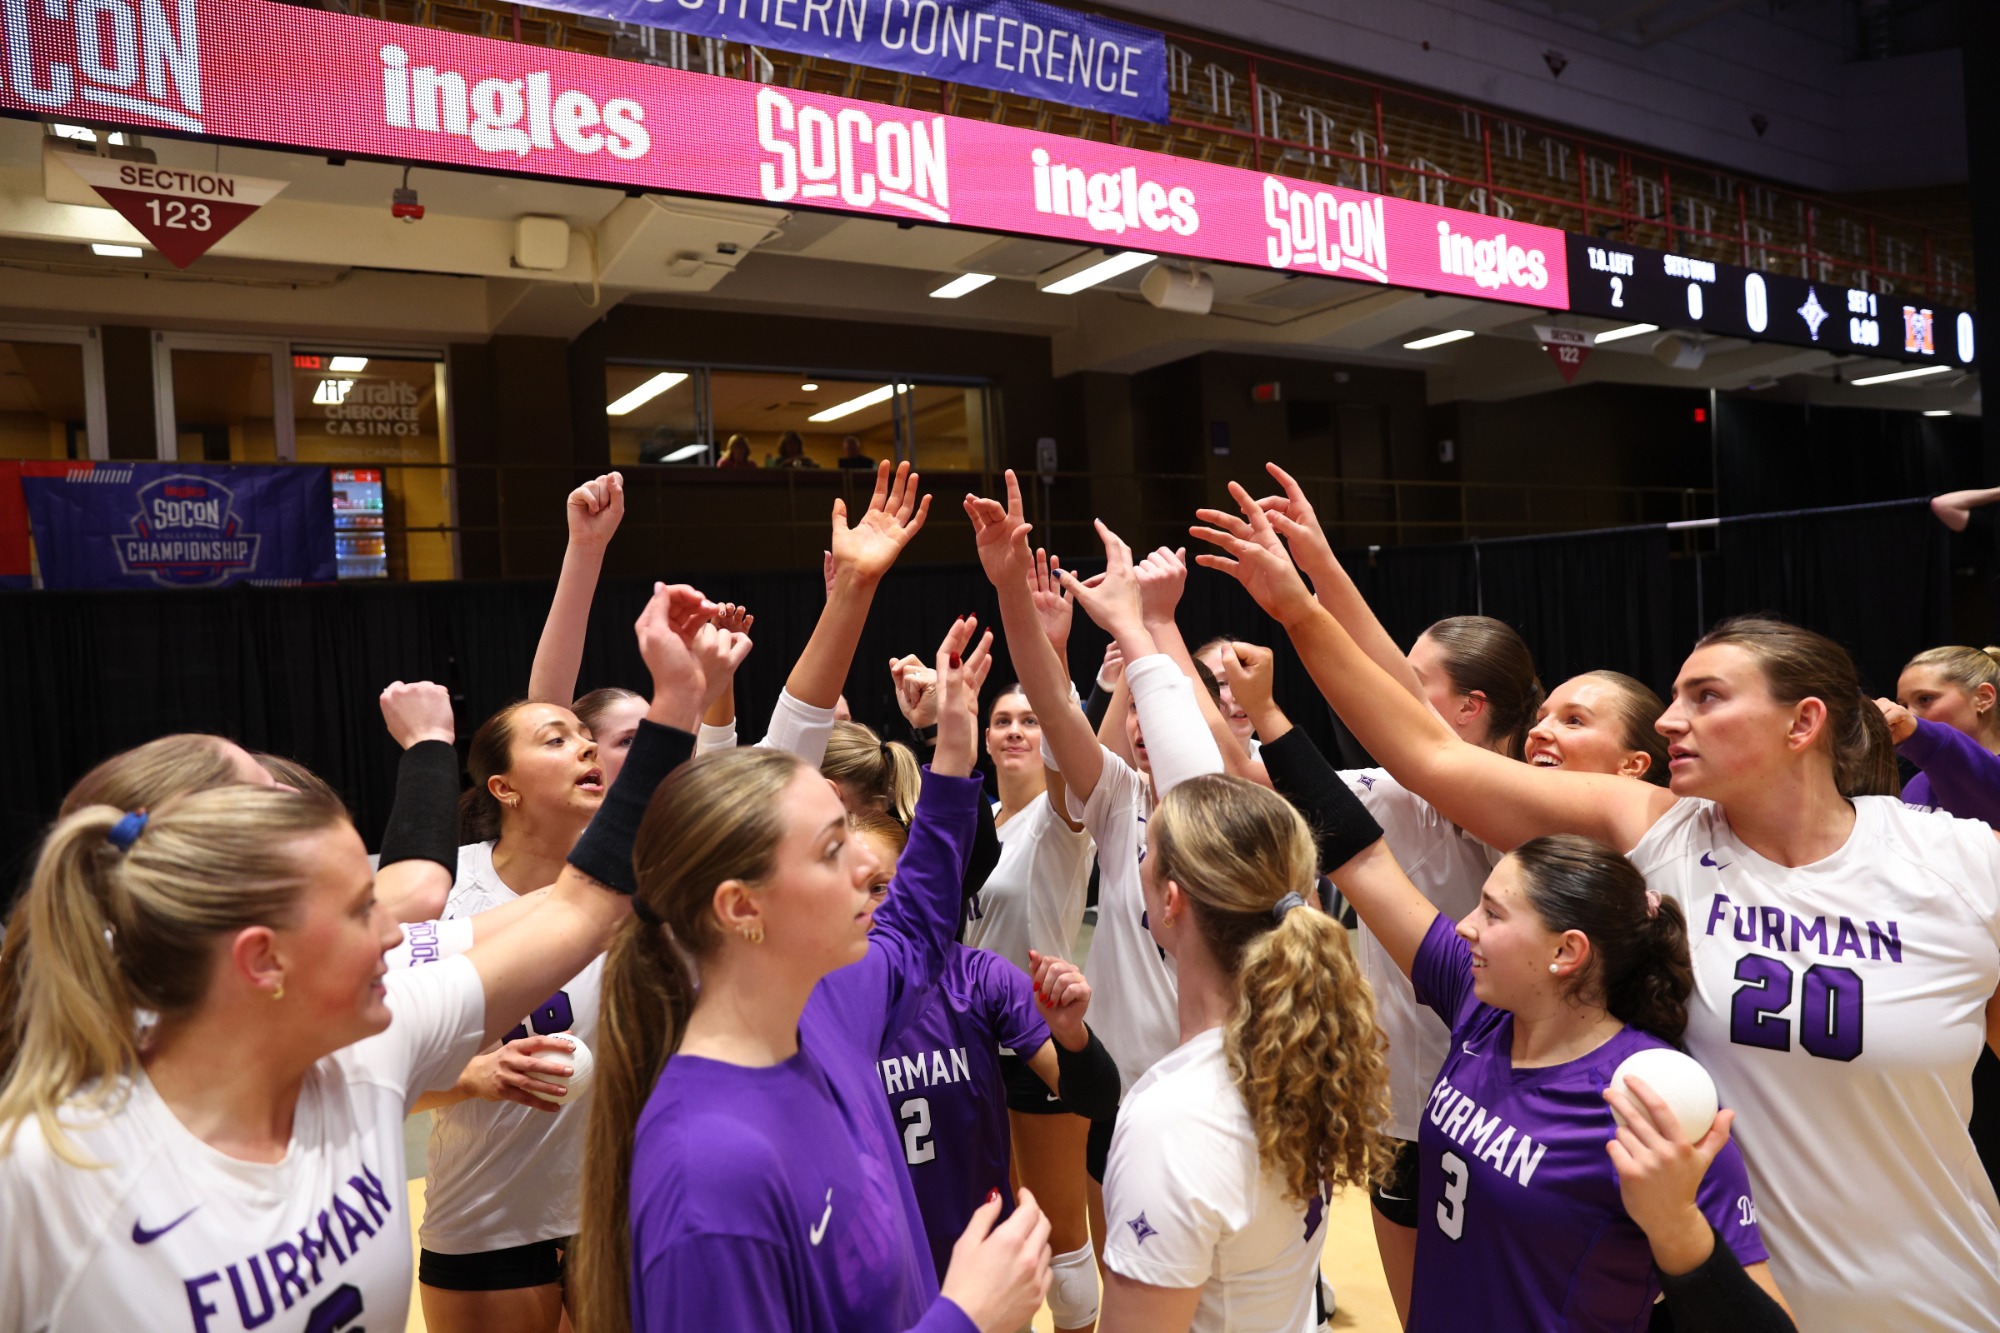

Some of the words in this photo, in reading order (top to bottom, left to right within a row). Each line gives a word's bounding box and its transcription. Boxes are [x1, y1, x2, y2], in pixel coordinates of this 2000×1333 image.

[880, 0, 1142, 97] CONFERENCE
[379, 43, 651, 160] ingles
[120, 165, 235, 197] SECTION
[1031, 148, 1199, 236] ingles
[146, 199, 212, 231] 123
[1437, 220, 1549, 290] ingles
[1610, 276, 1624, 308] 2
[1745, 272, 1768, 333] 0
[1559, 346, 1580, 363] 122
[1957, 311, 1974, 363] 0
[325, 405, 419, 420] CHEROKEE
[325, 421, 420, 436] CASINOS
[127, 541, 249, 562] CHAMPIONSHIP
[1706, 893, 1903, 963] FURMAN
[1730, 952, 1864, 1063] 20
[876, 1047, 971, 1095] RMAN
[900, 1097, 936, 1165] 2
[1426, 1075, 1548, 1188] FURMAN
[1436, 1150, 1470, 1241] 3
[184, 1161, 392, 1333] FURMAN
